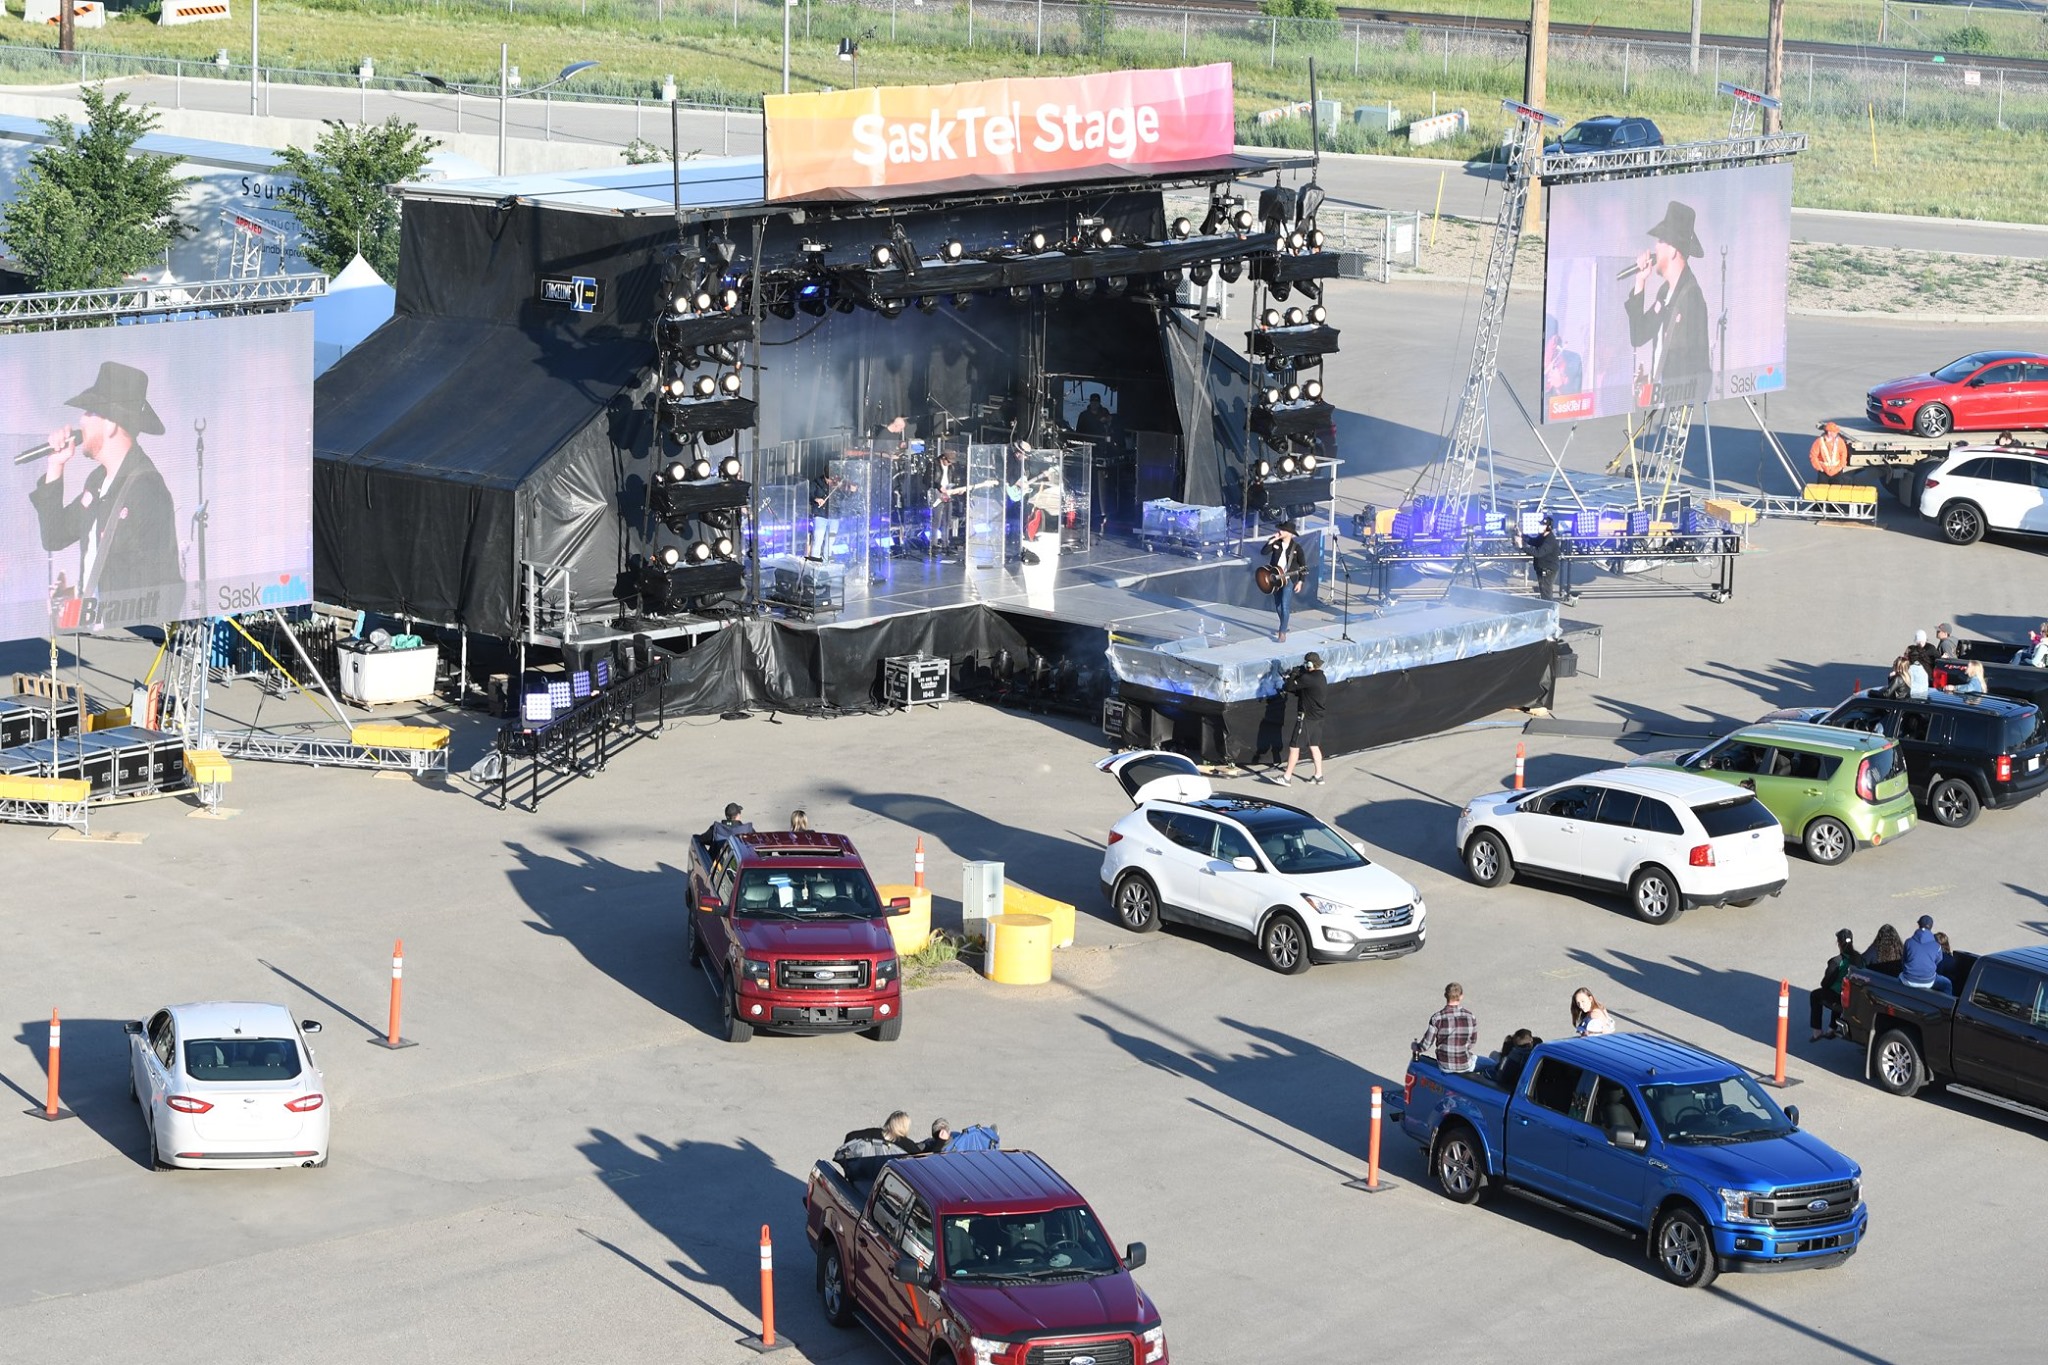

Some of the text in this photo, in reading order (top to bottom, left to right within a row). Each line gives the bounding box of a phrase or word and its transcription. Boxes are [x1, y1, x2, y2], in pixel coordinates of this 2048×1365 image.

[1733, 87, 1761, 103] APPLIED
[1516, 105, 1544, 121] APPLIED
[852, 100, 1159, 165] SaskTel Stage
[234, 216, 262, 235] APPLIED
[545, 282, 572, 300] STAGELINE
[79, 590, 160, 625] Brandt
